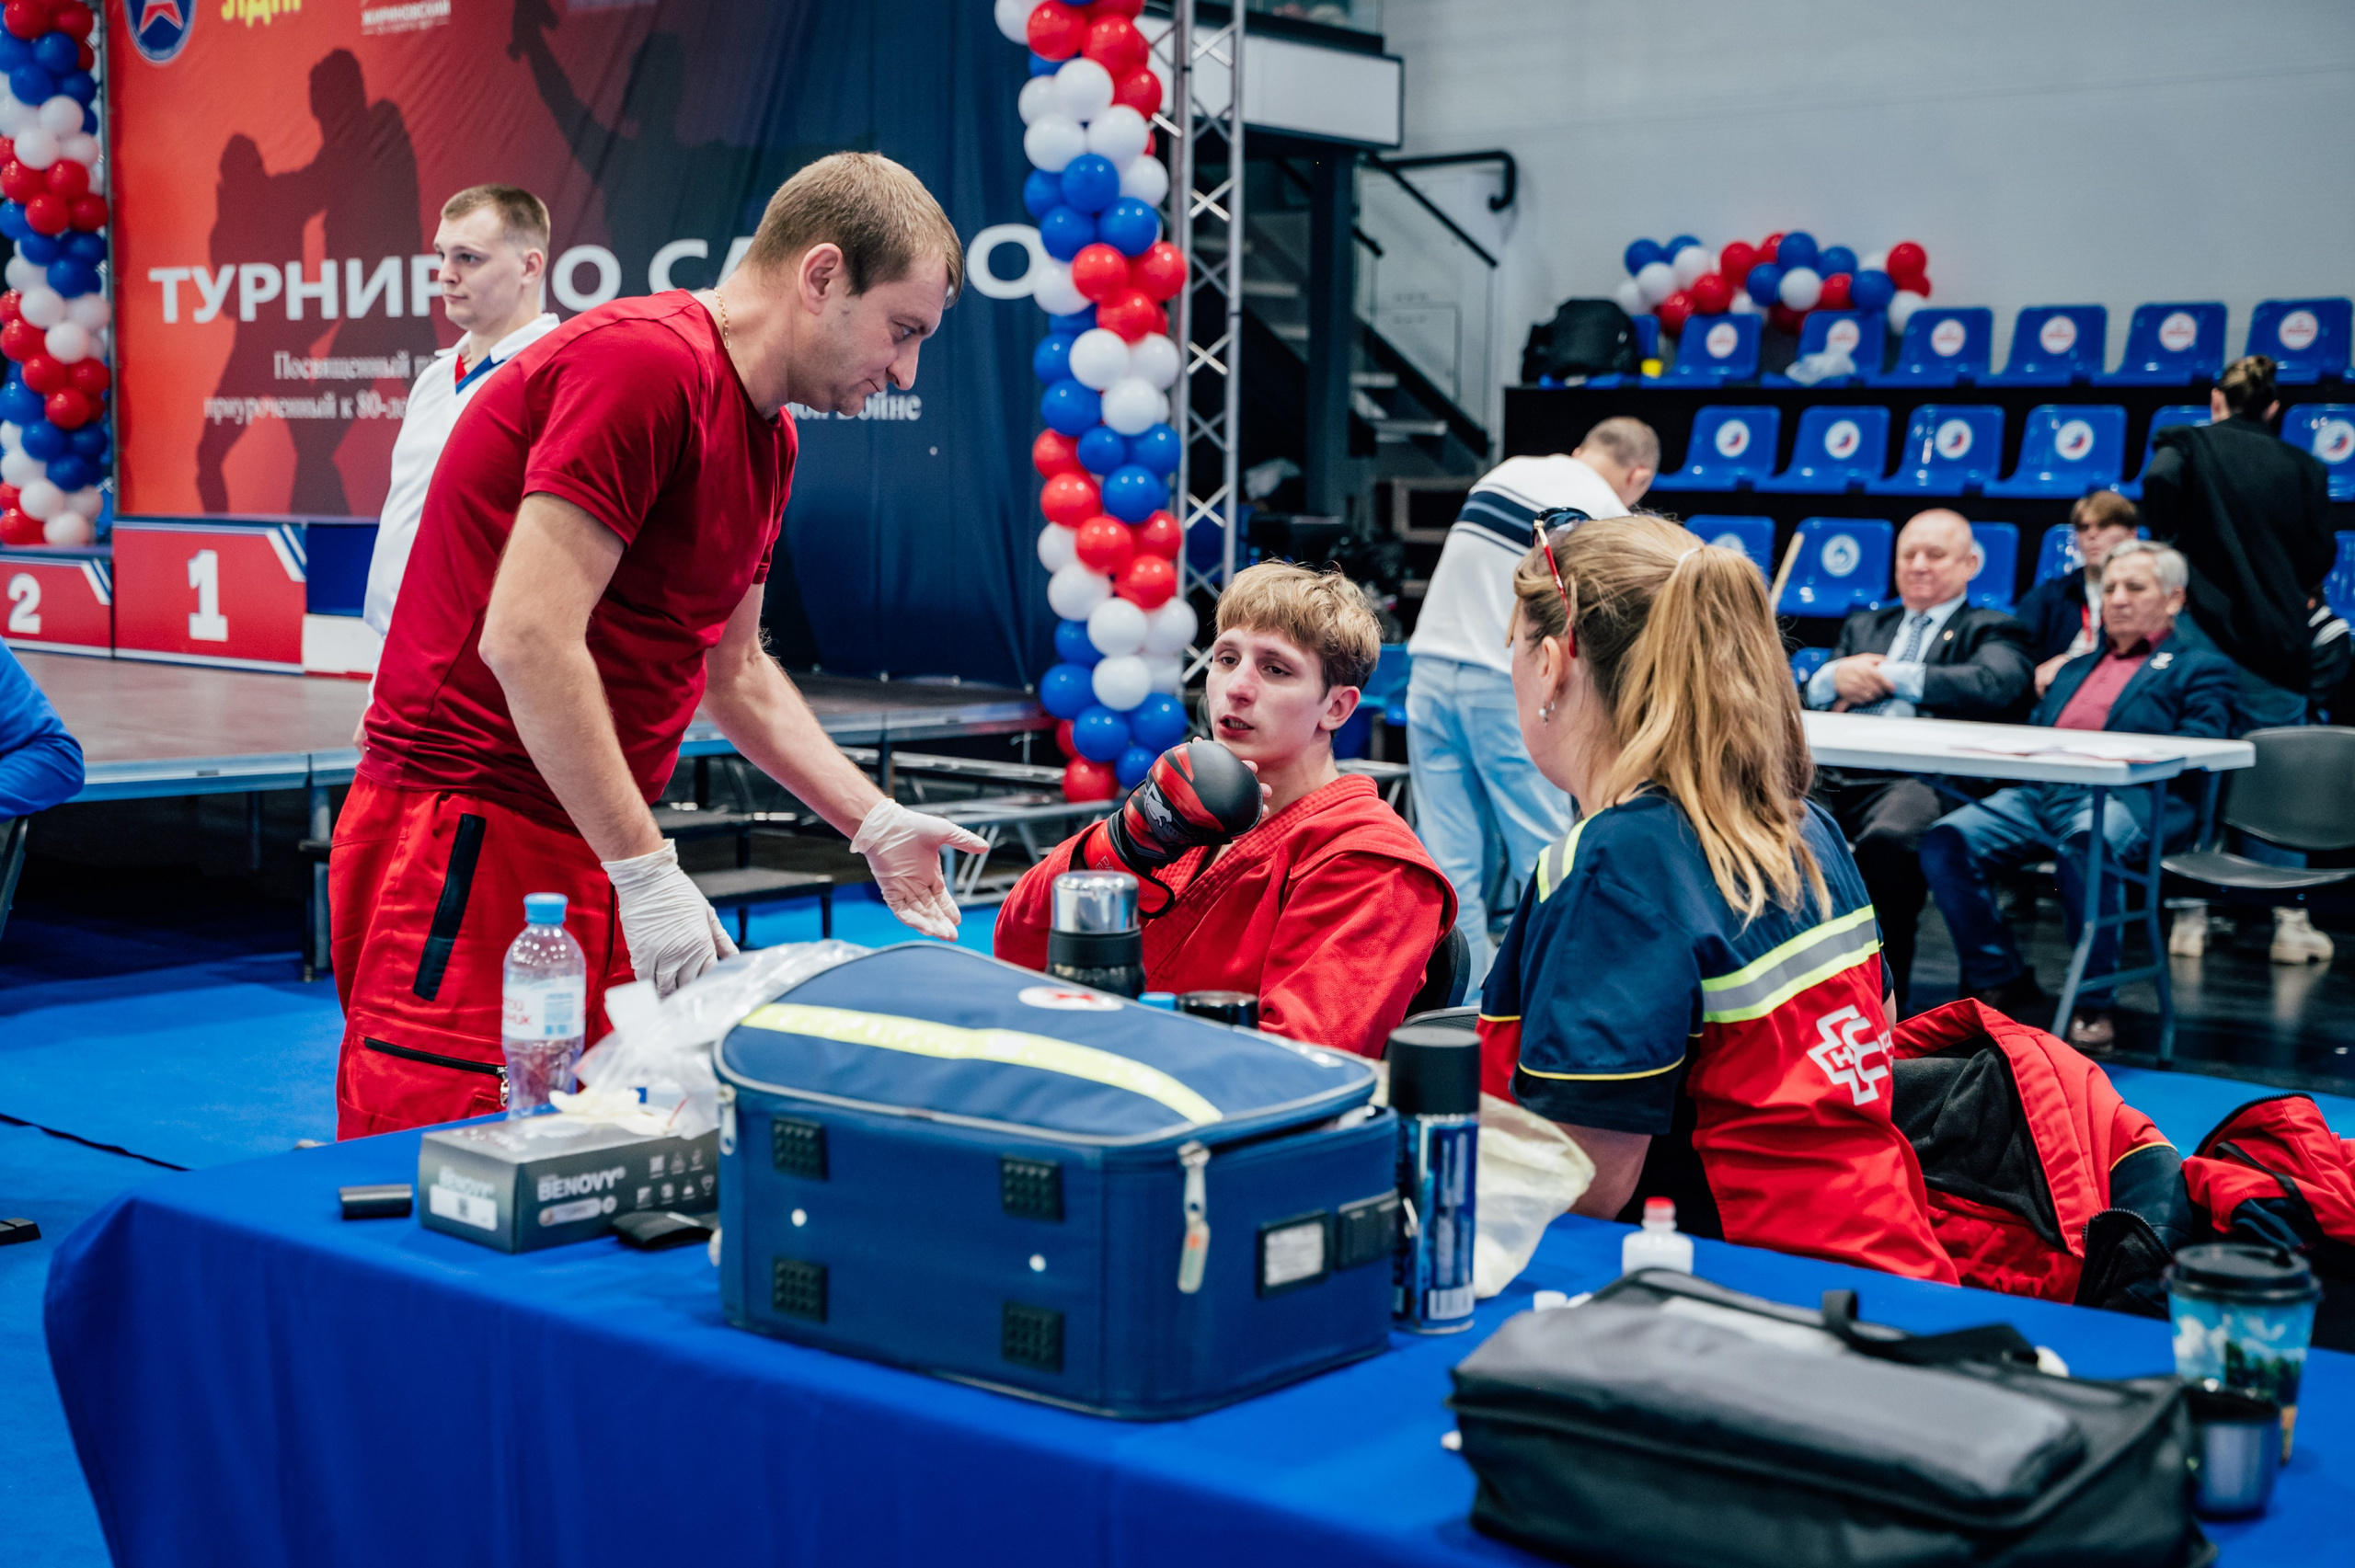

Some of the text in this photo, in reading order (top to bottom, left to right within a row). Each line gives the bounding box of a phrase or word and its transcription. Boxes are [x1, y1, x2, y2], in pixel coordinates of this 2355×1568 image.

[148, 254, 444, 325] ТУРНИР
[7, 572, 41, 634] 2
[188, 549, 228, 642] 1
[538, 1169, 617, 1202] BENOVY
